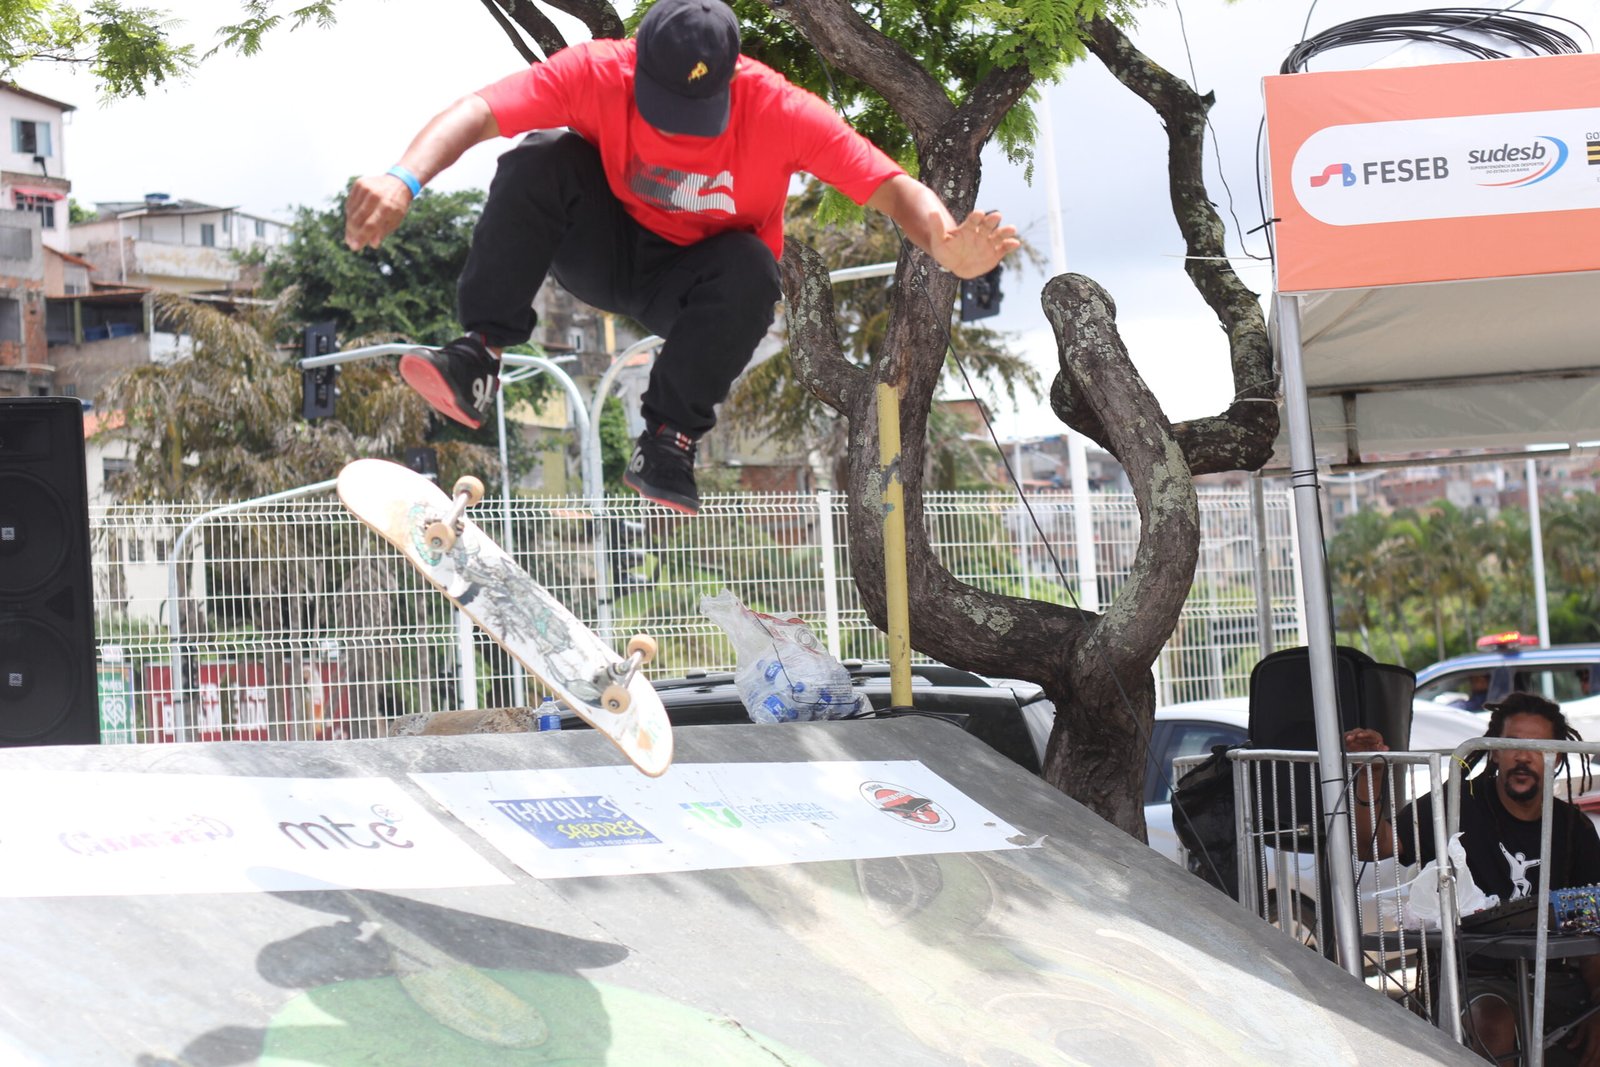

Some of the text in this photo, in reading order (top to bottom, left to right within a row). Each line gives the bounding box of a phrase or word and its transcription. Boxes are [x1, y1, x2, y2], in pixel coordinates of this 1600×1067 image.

[1586, 131, 1600, 141] GO
[1468, 141, 1546, 164] sudesb
[1363, 156, 1449, 185] FESEB
[556, 820, 646, 840] SABORES
